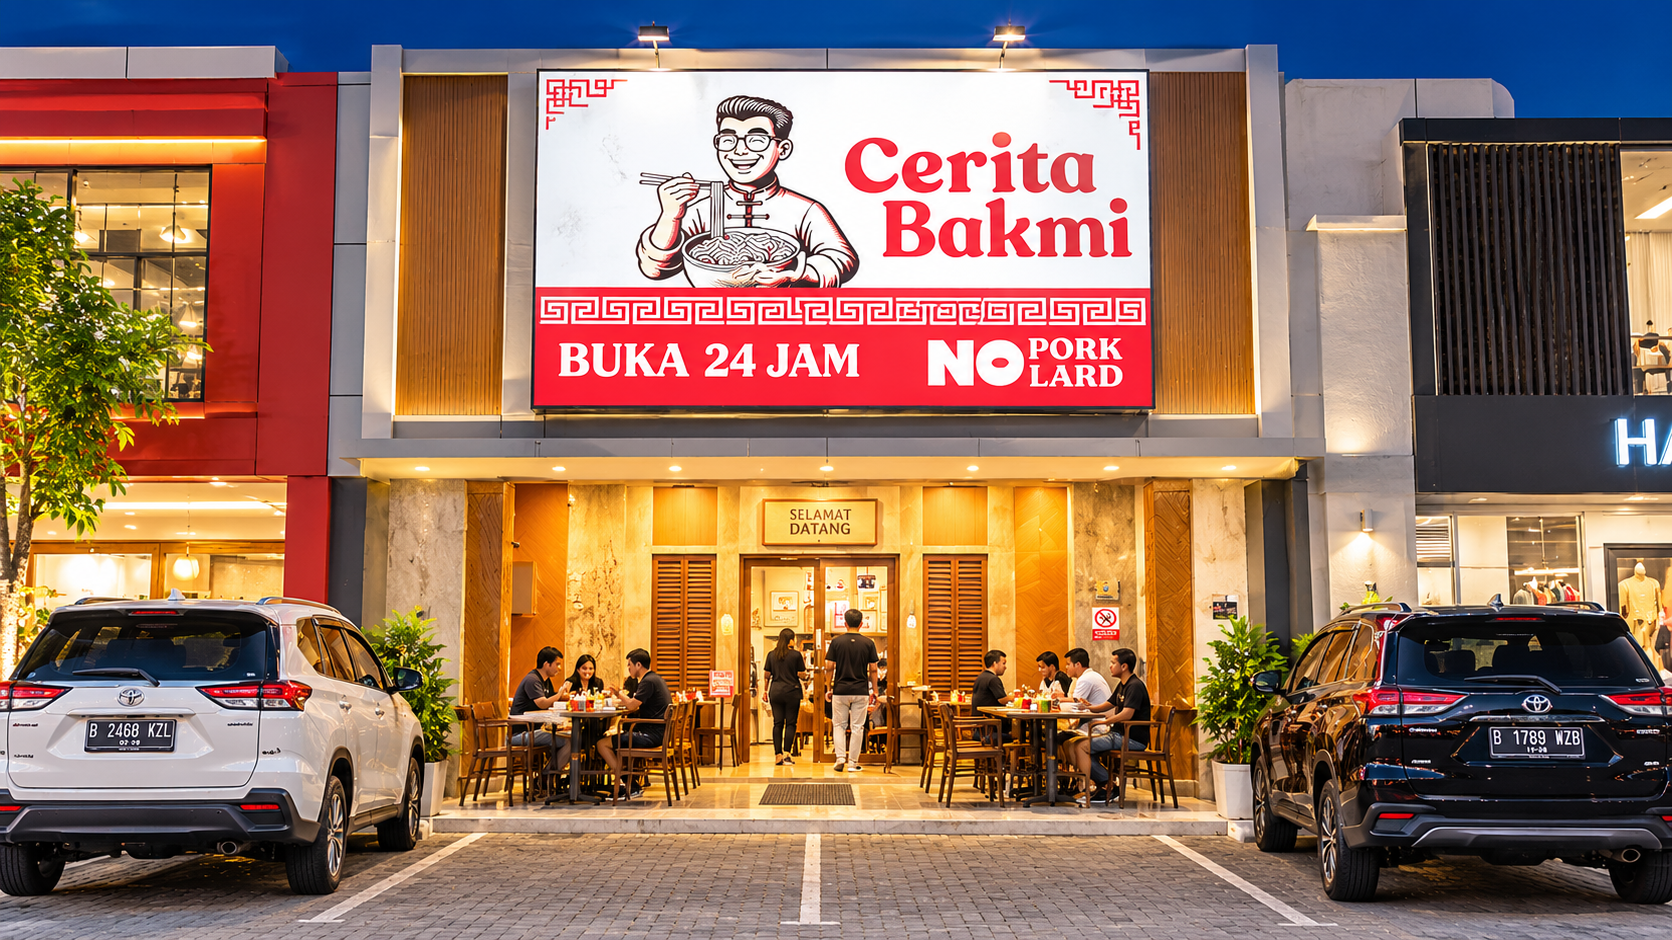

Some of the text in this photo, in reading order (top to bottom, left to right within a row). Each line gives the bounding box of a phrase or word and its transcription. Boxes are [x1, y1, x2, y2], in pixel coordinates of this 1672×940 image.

[844, 131, 1098, 196] Cerita
[883, 197, 1134, 258] Bakmi
[1028, 337, 1124, 360] PORK
[558, 342, 860, 380] BUKA 24 JAM
[927, 339, 1025, 387] NO
[1028, 364, 1124, 388] LARD
[789, 508, 852, 521] SELAMAT
[789, 522, 851, 535] DATANG
[89, 722, 172, 738] B 2468 KZL
[1492, 729, 1581, 746] B 1789 WZB
